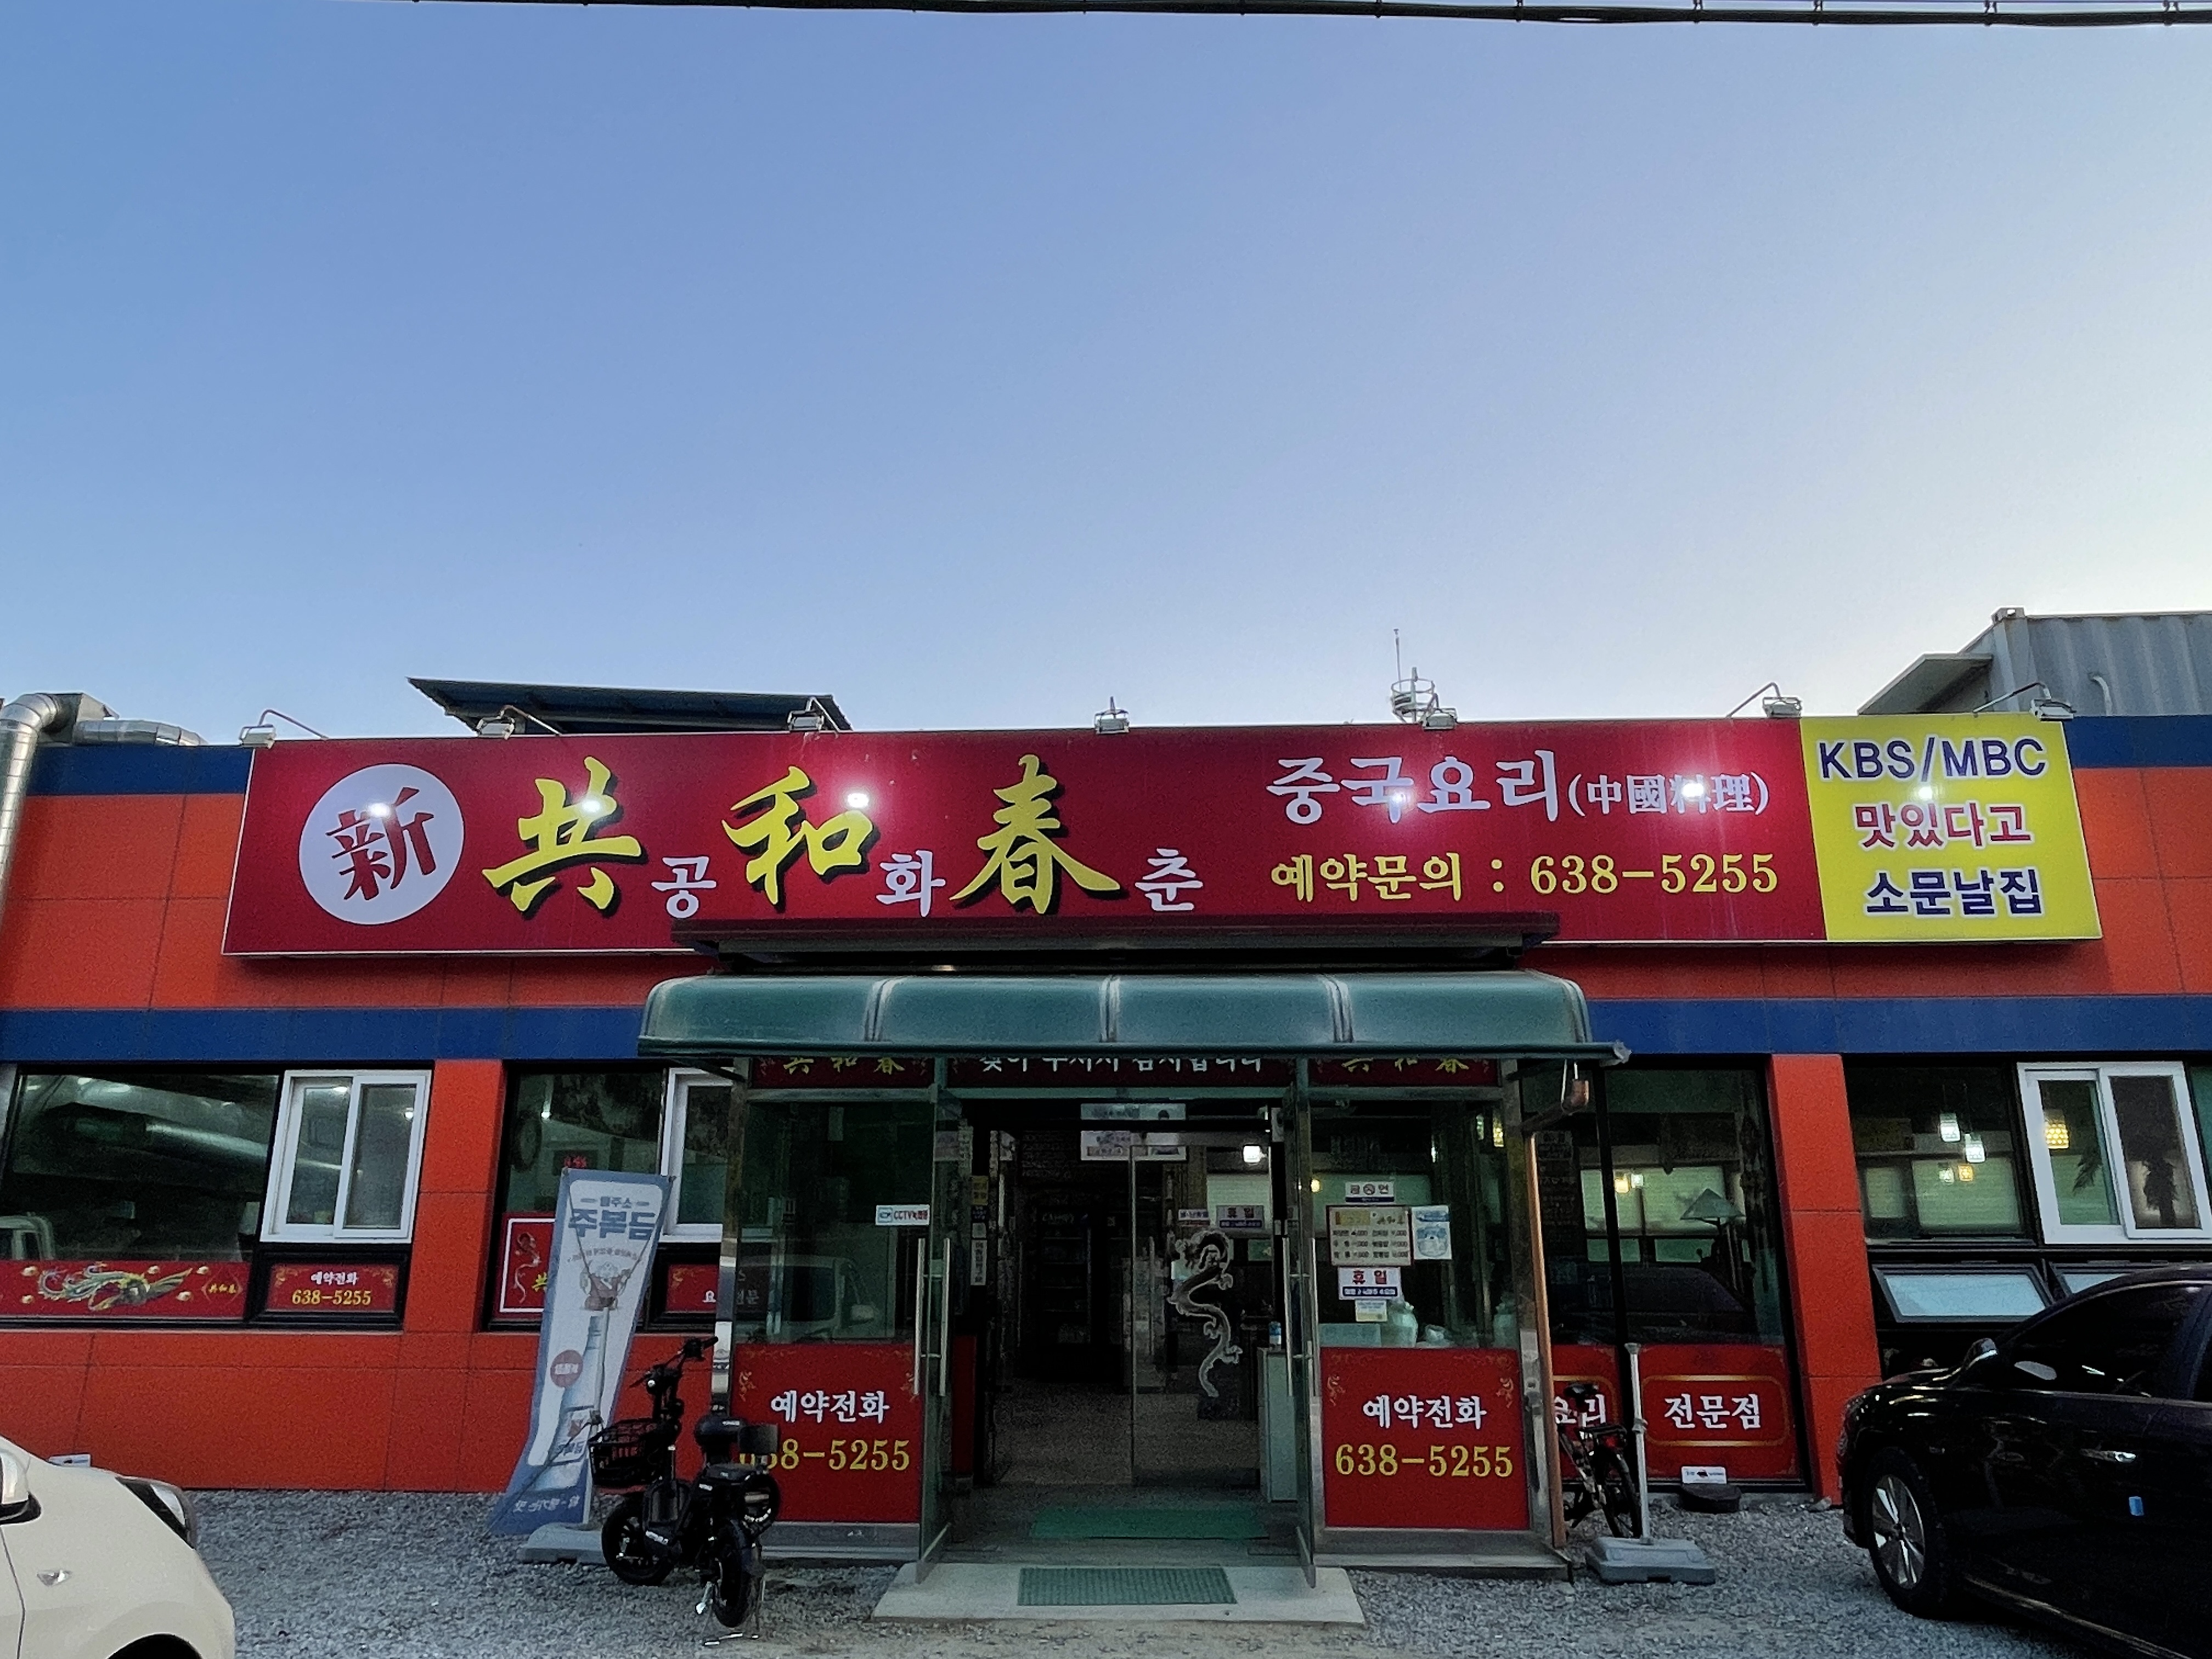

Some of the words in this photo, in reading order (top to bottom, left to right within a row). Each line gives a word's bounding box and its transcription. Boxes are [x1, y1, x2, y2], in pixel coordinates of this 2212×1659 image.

[1819, 737, 2046, 782] KBS/MBC
[1855, 803, 2032, 848] 맛있다고
[326, 787, 435, 901] 新
[1271, 852, 1461, 902] 예약문의
[1530, 853, 1780, 895] 638-5255
[311, 1271, 360, 1286] 예약전화
[292, 1289, 372, 1306] 638-5255
[770, 1390, 890, 1423] 예약전화
[1363, 1395, 1488, 1430] 예약전화
[1664, 1393, 1761, 1430] 전문점
[1335, 1443, 1514, 1478] 638-5255
